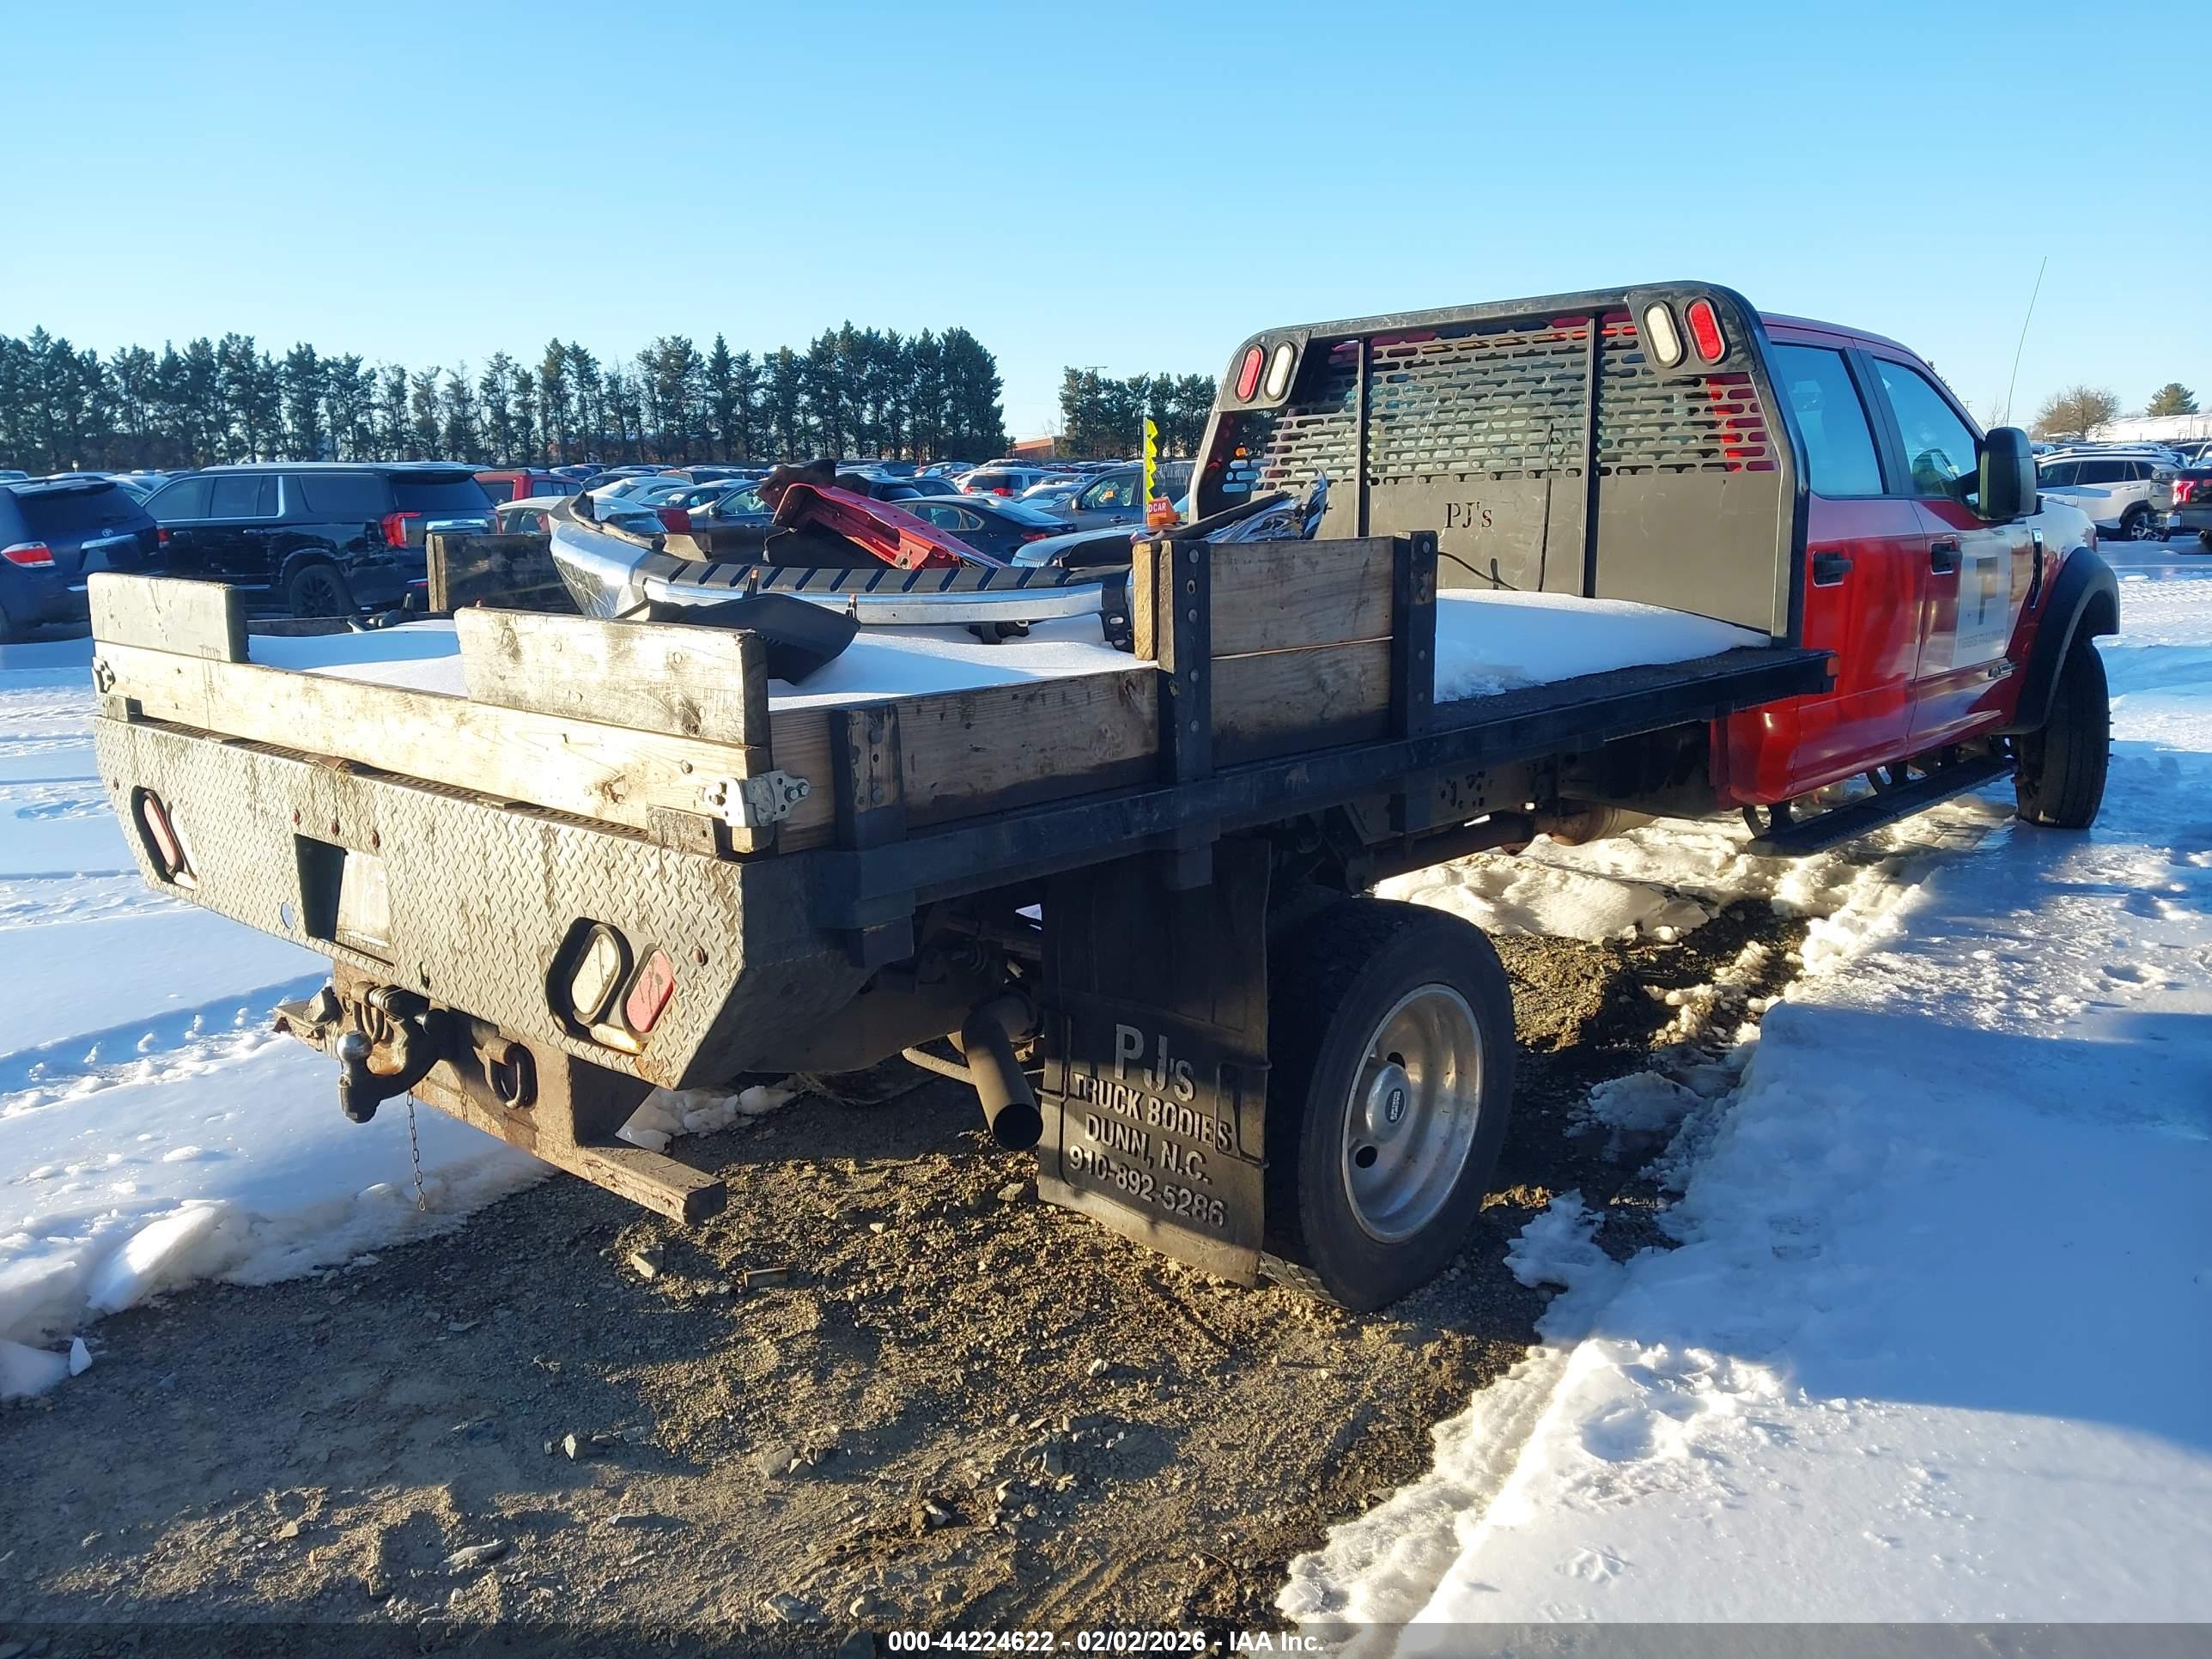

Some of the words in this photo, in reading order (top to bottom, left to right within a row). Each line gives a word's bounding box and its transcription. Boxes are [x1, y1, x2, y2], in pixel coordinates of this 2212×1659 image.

[1444, 501, 1492, 528] PJ's
[1073, 1073, 1144, 1121] TRUCK
[1147, 1096, 1232, 1152] BODIES
[1069, 1145, 1224, 1228] 910-892-5286
[1160, 1139, 1212, 1185] N.C.
